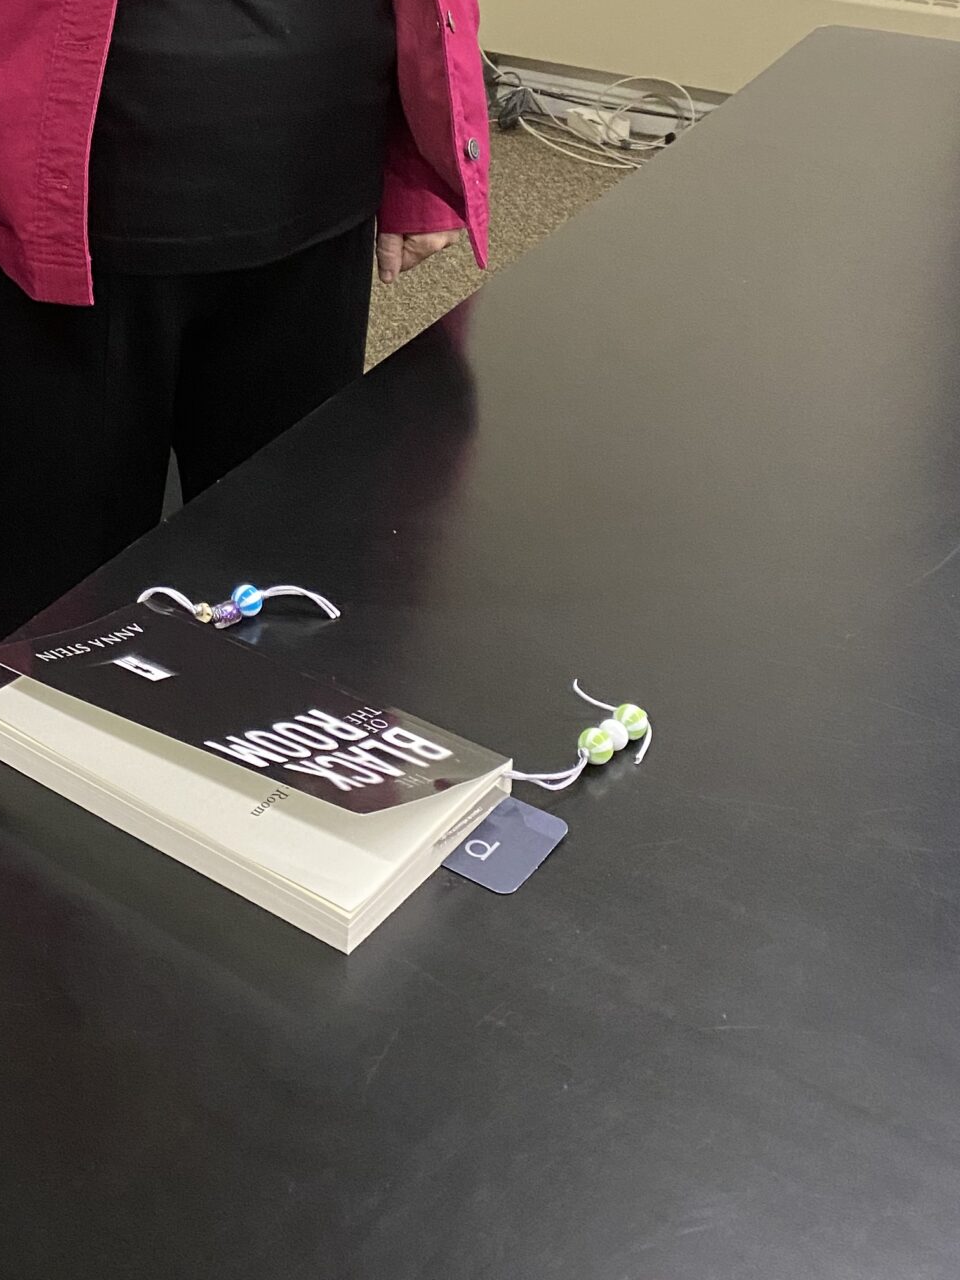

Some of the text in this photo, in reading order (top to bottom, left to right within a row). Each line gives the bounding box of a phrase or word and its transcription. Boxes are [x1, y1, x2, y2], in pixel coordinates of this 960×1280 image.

[35, 622, 144, 662] ANNA STEIN
[343, 706, 383, 725] THE
[365, 718, 389, 734] OF
[203, 708, 370, 768] ROOM
[283, 726, 454, 792] BLACK
[394, 771, 435, 789] THE
[250, 788, 289, 818] Room
